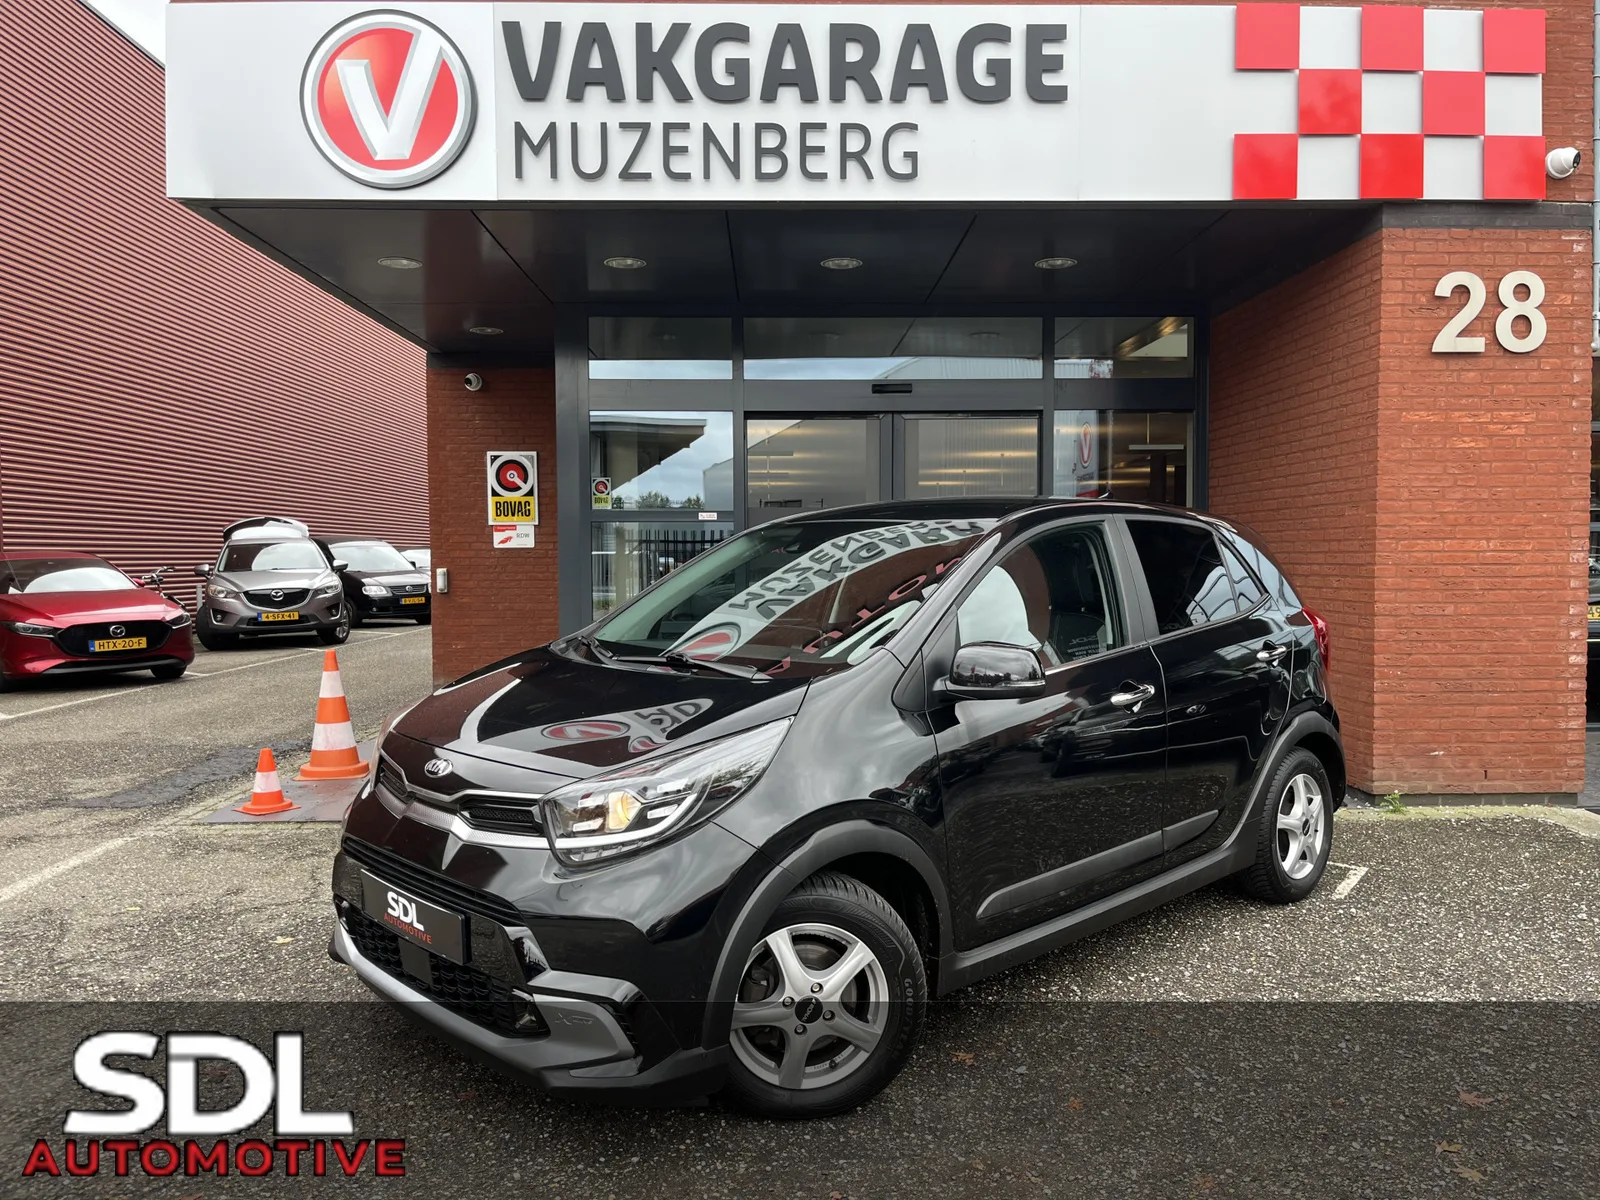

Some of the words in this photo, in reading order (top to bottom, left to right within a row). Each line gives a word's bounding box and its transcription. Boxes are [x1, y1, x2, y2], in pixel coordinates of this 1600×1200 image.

[500, 20, 1068, 103] VAKGARAGE
[513, 121, 920, 182] MUZENBERG
[1431, 270, 1547, 353] 28
[495, 500, 531, 517] BOVAG
[98, 638, 144, 650] HTX-20-F
[383, 912, 433, 945] AUTOMOTIVE
[387, 891, 425, 931] SDL
